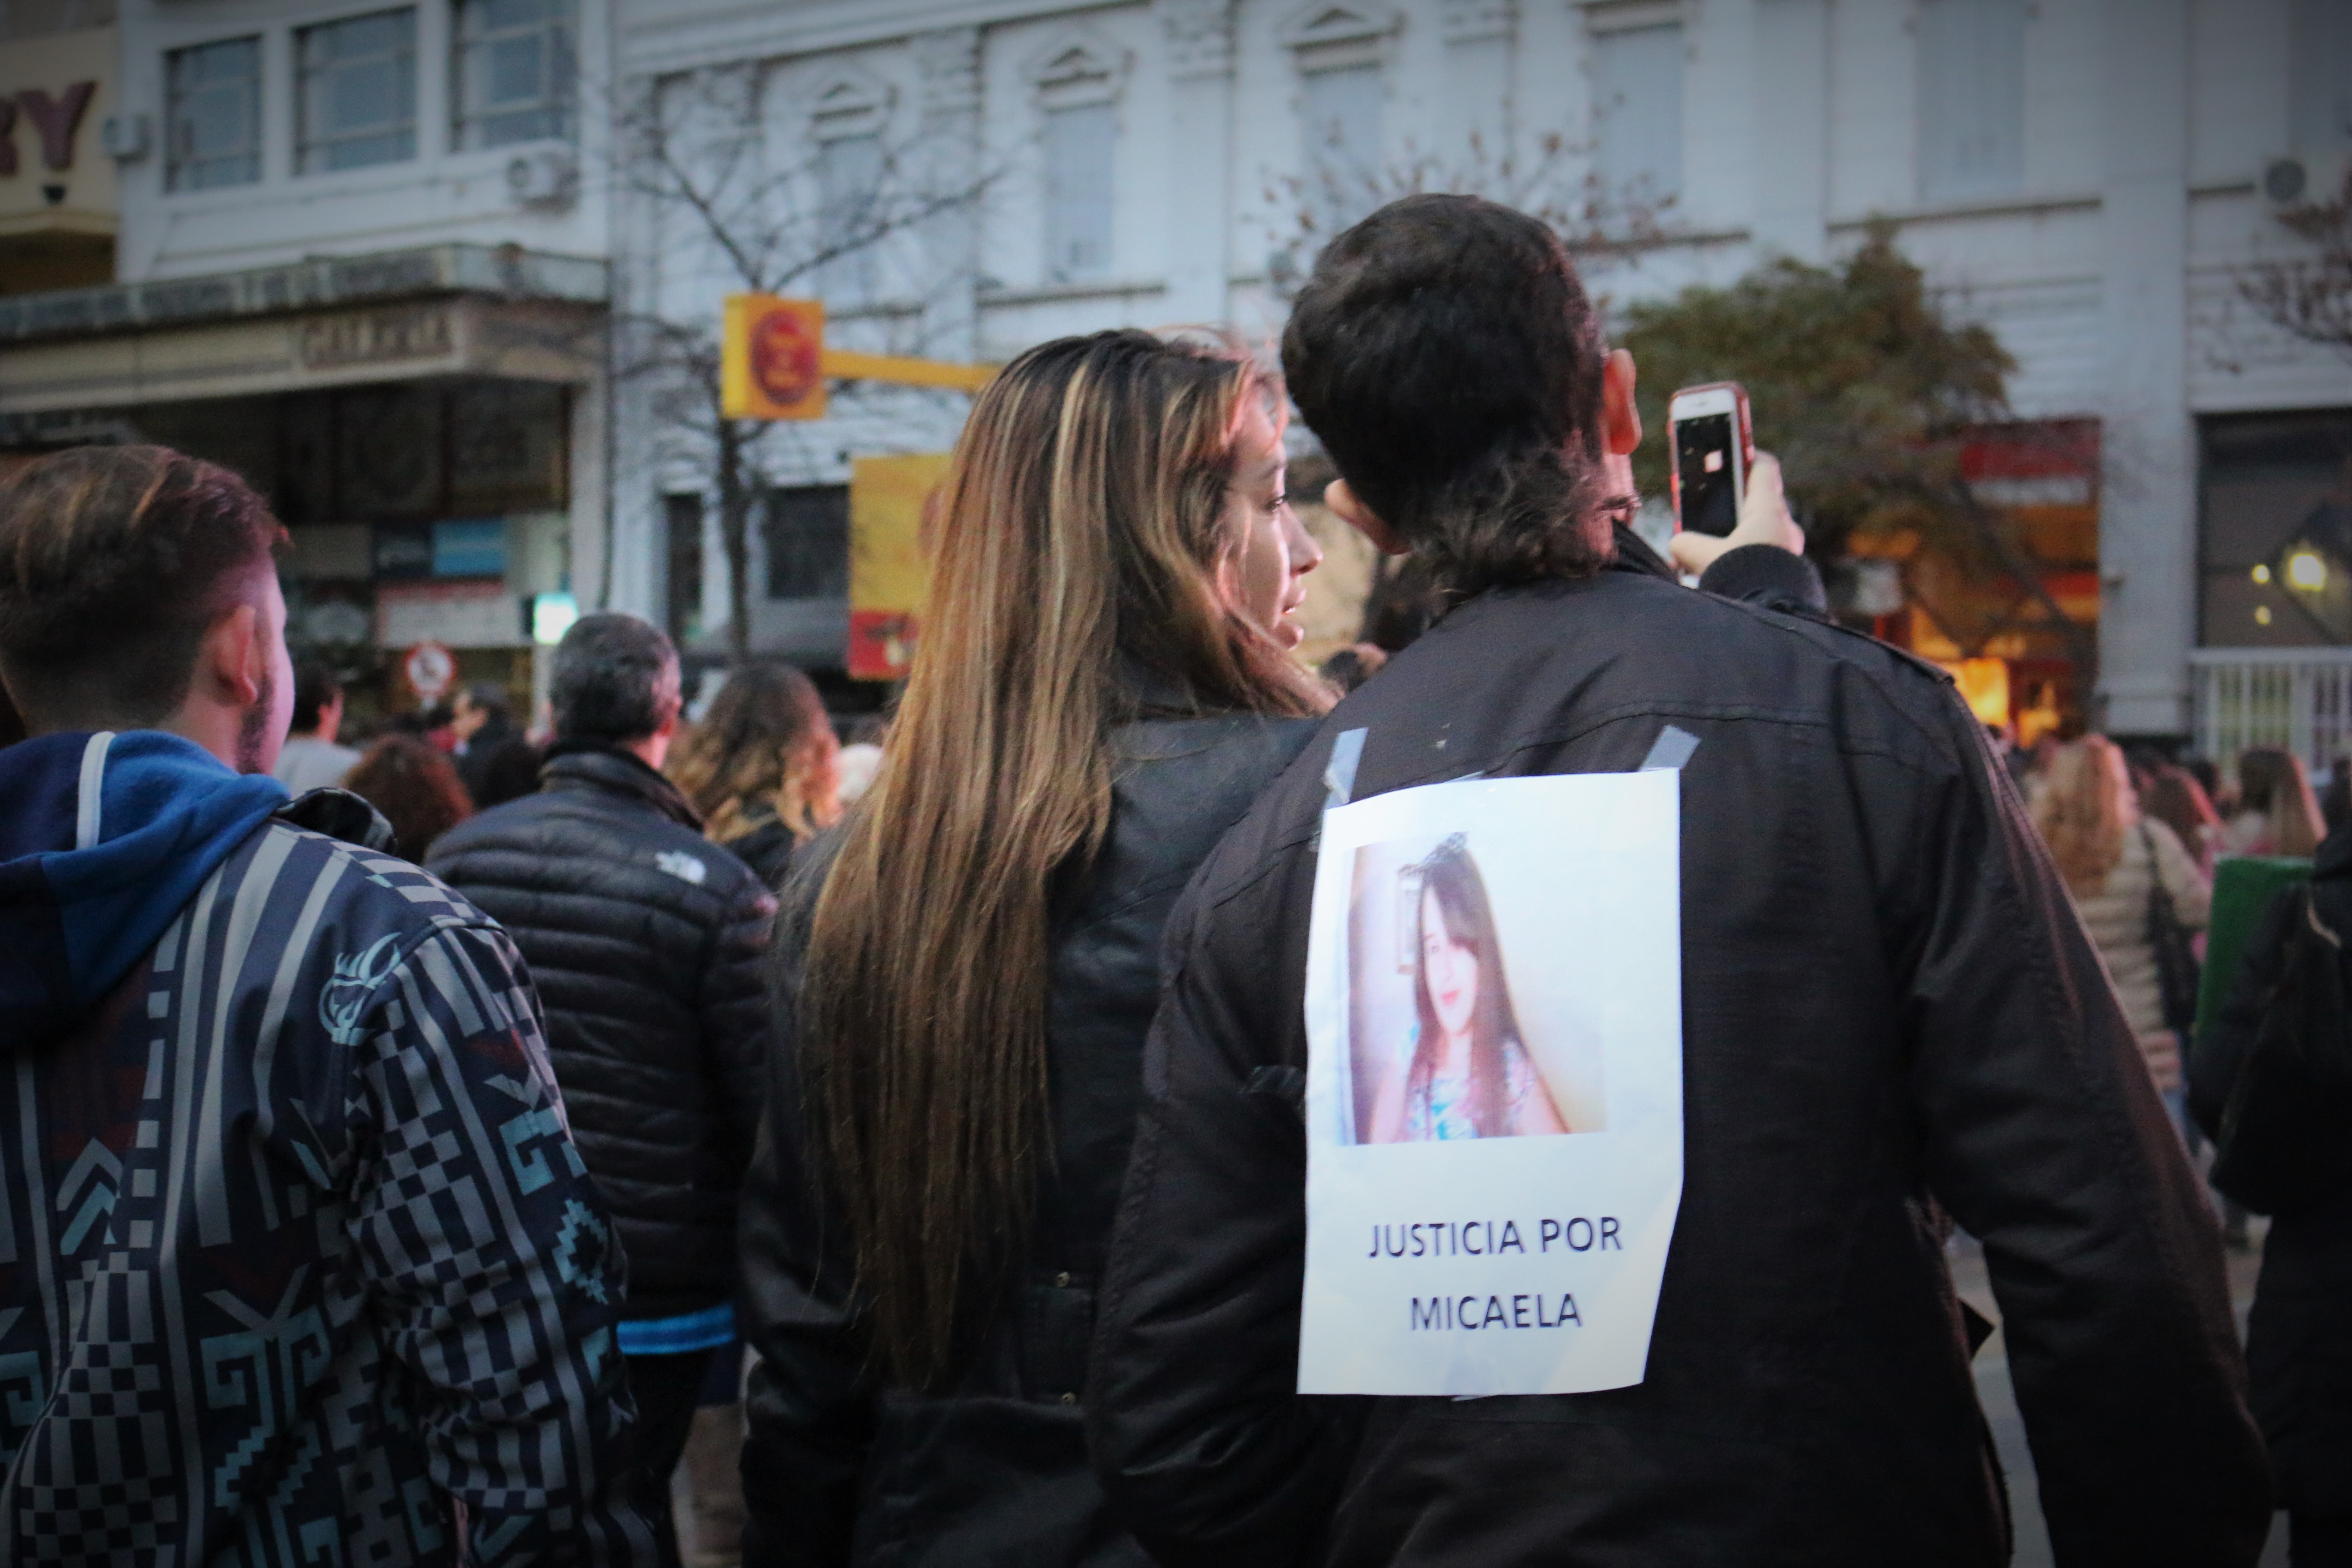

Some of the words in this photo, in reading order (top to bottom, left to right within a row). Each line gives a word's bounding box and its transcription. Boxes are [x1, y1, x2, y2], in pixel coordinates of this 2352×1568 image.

[1369, 1220, 1526, 1258] JUSTICIA
[1540, 1216, 1623, 1253] POR
[1411, 1292, 1583, 1331] MICAELA
